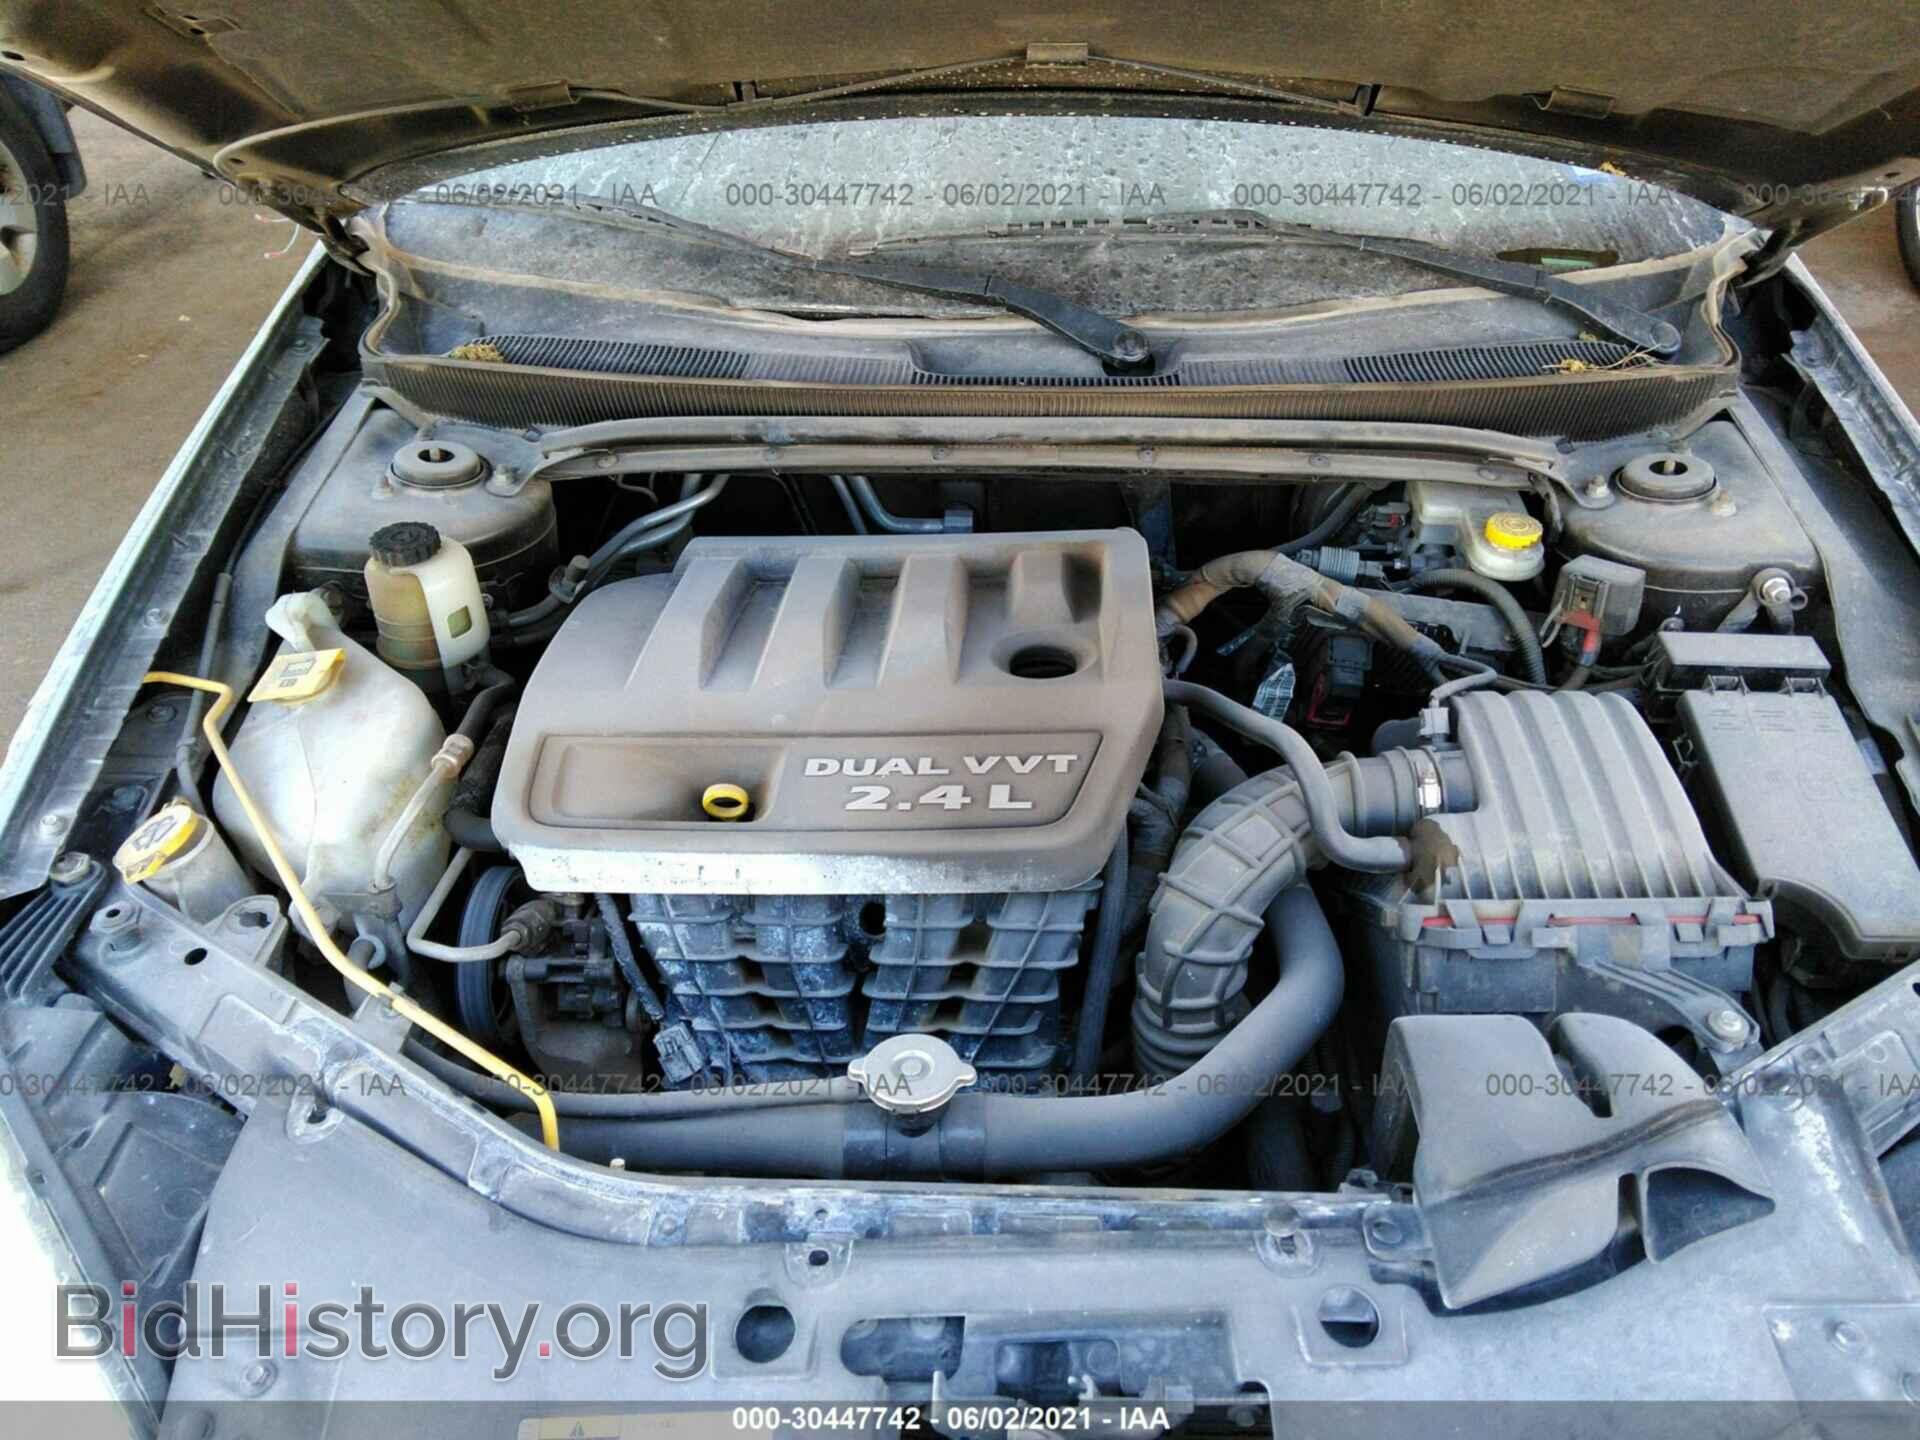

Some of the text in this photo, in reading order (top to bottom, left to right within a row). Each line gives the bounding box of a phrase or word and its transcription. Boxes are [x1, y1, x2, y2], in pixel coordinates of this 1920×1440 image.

[804, 754, 1078, 777] DUAL VVT
[845, 784, 1032, 810] 2.4 L
